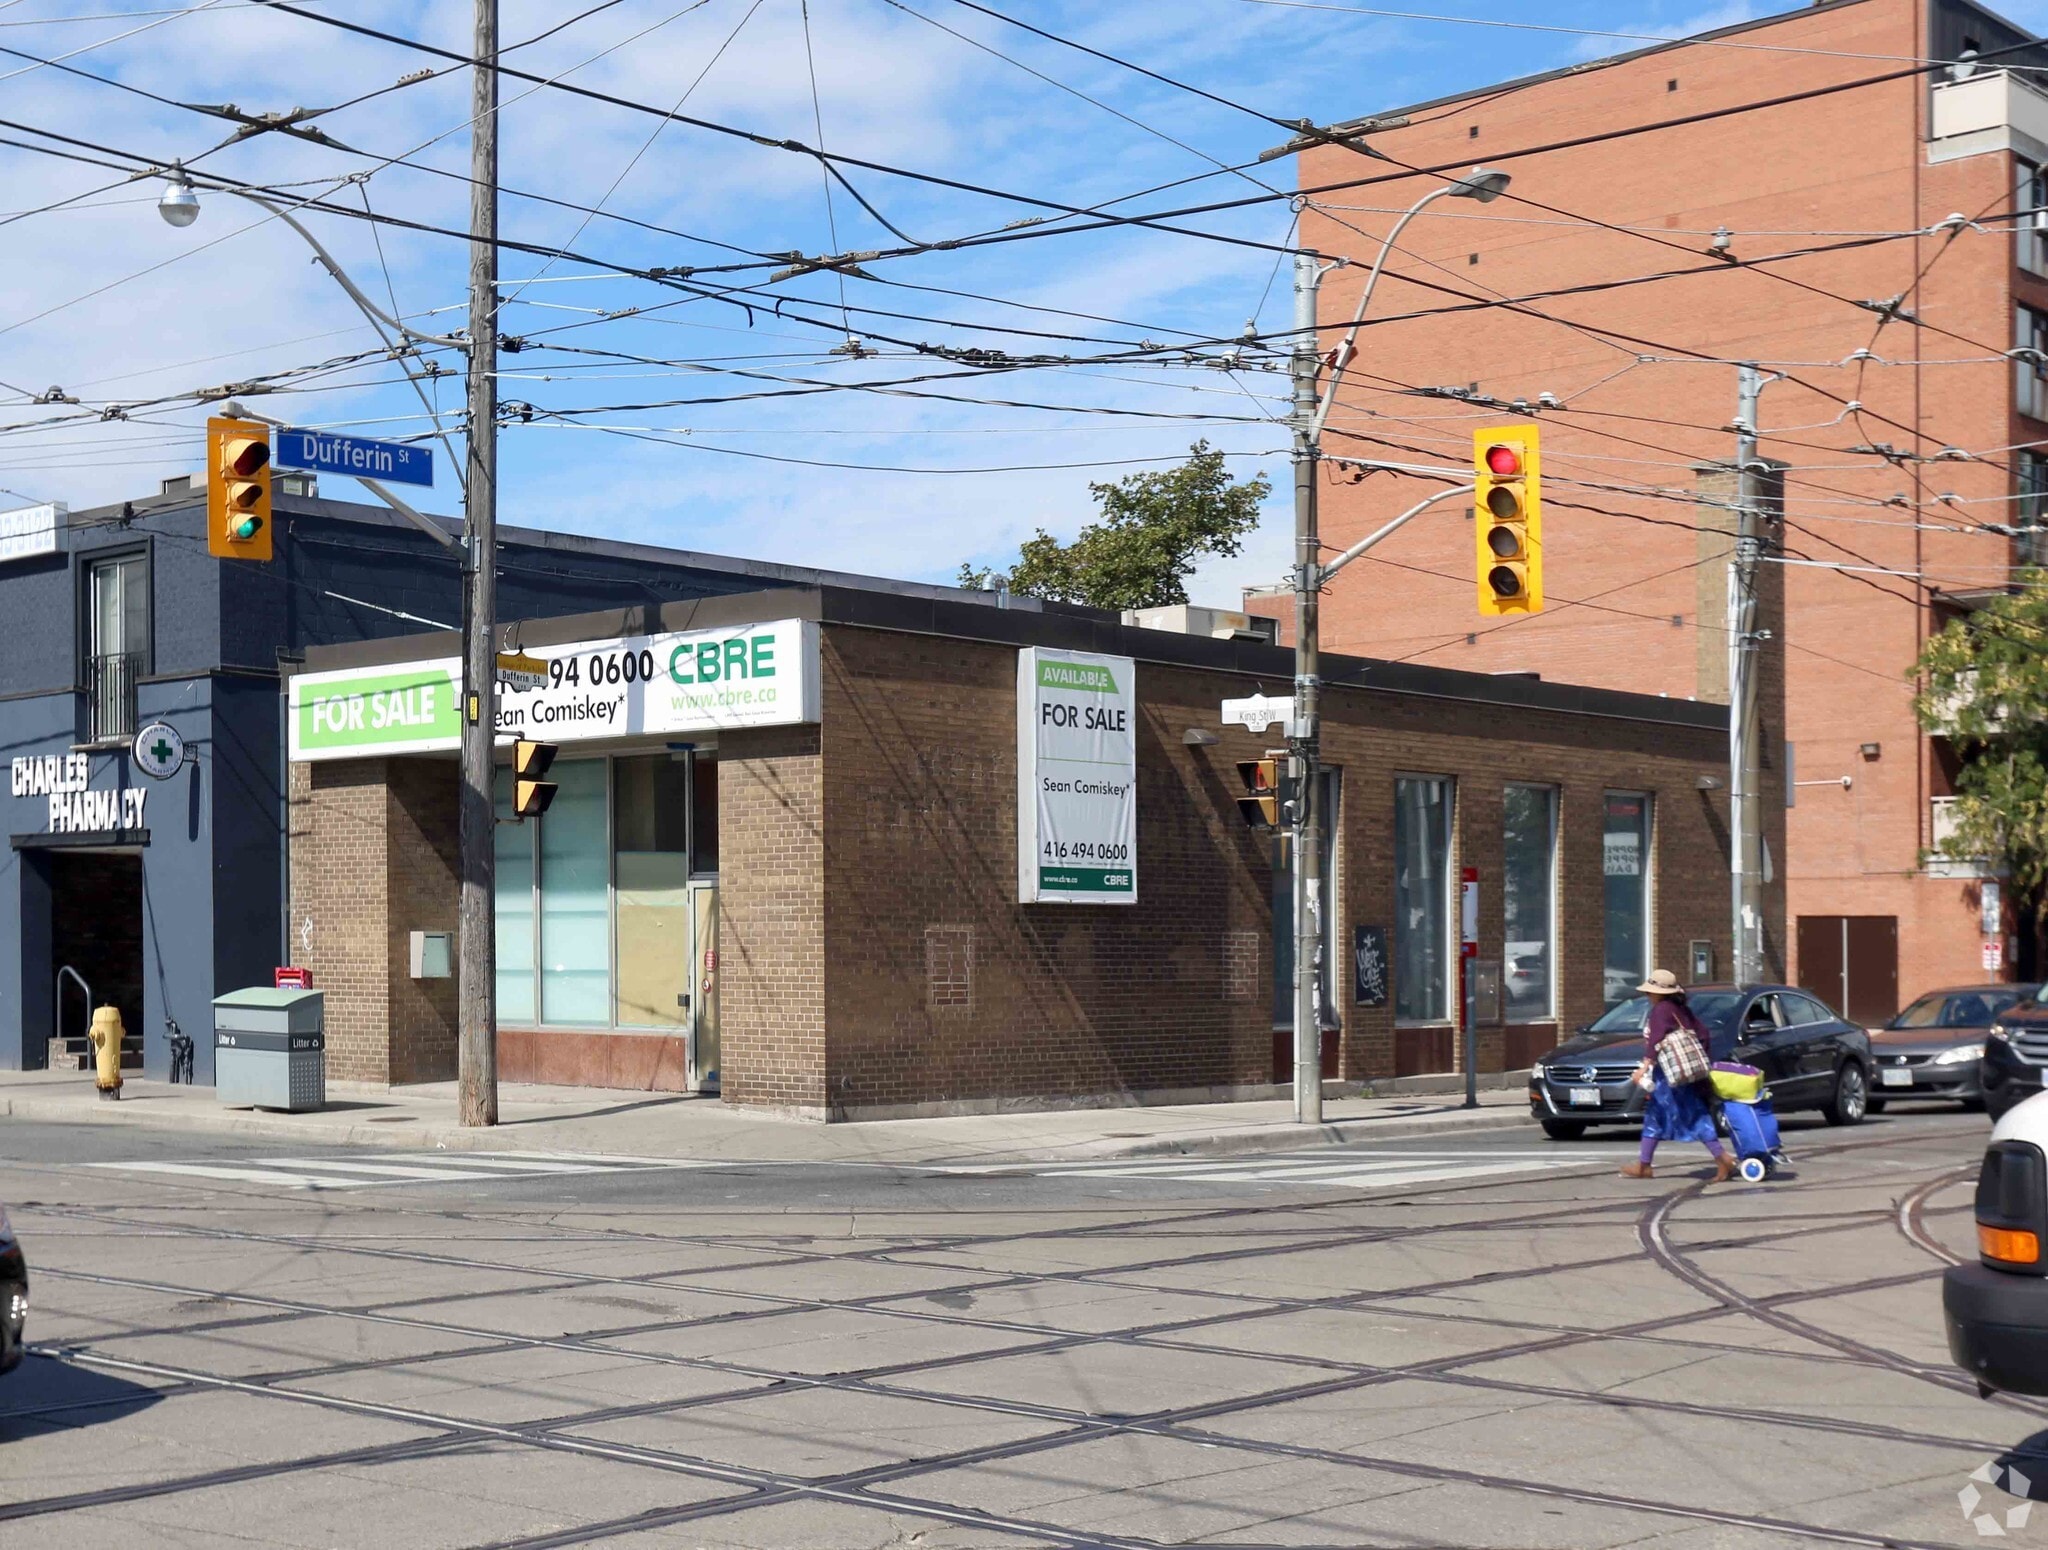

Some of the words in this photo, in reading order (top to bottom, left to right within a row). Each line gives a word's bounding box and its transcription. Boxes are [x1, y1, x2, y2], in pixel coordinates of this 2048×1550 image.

[303, 434, 392, 472] Dufferin
[398, 449, 410, 464] St
[549, 658, 580, 690] 94
[589, 649, 654, 687] 0600
[669, 634, 776, 685] CBRE
[502, 670, 530, 683] Dufferin
[1043, 667, 1108, 688] AVAILABLE
[671, 685, 777, 710] www.cbre.ca
[312, 694, 365, 735] FOR
[371, 685, 435, 730] SALE
[494, 709, 525, 727] ean
[1042, 703, 1079, 728] FOR
[1085, 707, 1126, 732] SALE
[1239, 711, 1257, 724] King
[1268, 708, 1277, 721] W
[140, 726, 182, 747] CHARLES
[12, 752, 88, 796] CHARLES
[1043, 777, 1071, 793] Sean
[50, 787, 147, 833] PHARMACY
[1043, 841, 1068, 858] 416
[1071, 842, 1094, 858] 494
[1097, 843, 1128, 860] 0600
[1103, 874, 1129, 886] CBRE
[218, 1033, 230, 1045] Litter
[293, 1038, 310, 1049] Litter
